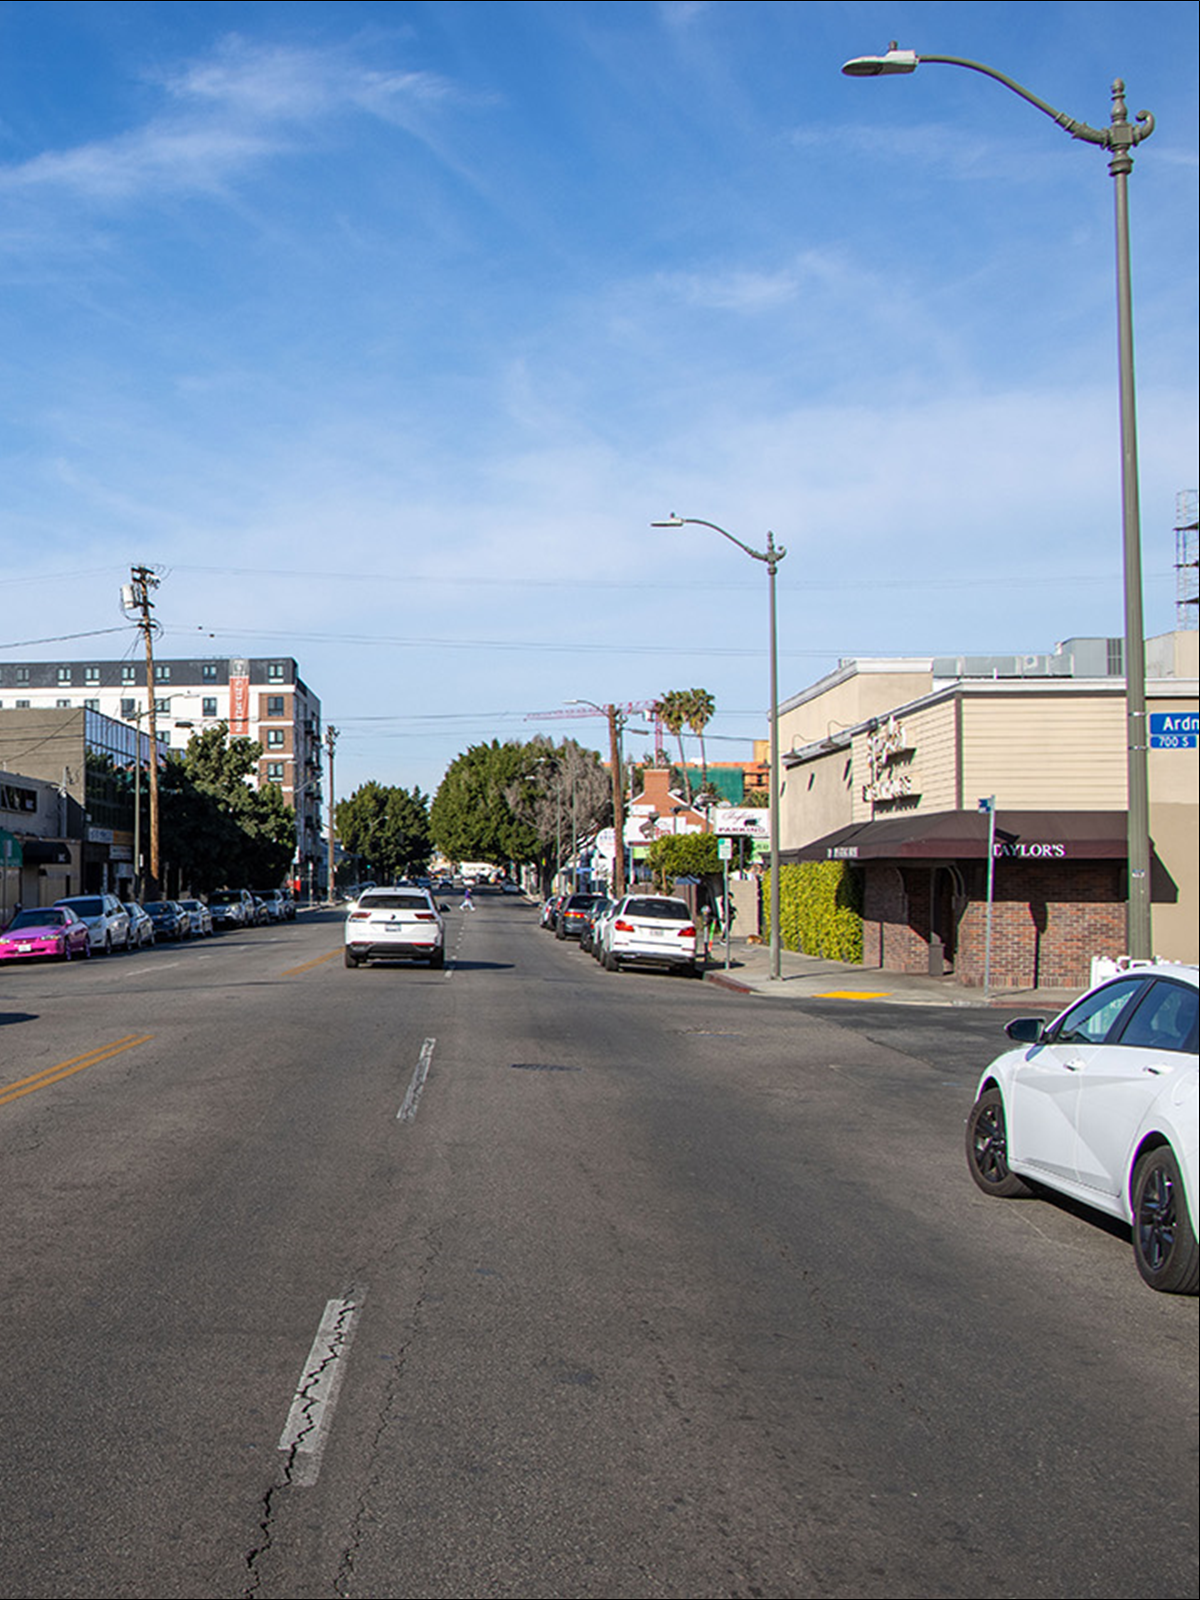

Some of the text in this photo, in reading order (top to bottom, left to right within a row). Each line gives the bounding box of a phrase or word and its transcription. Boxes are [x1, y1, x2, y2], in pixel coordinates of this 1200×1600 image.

[1159, 736, 1190, 747] 700 S
[993, 843, 1066, 857] TAYLOR'S
